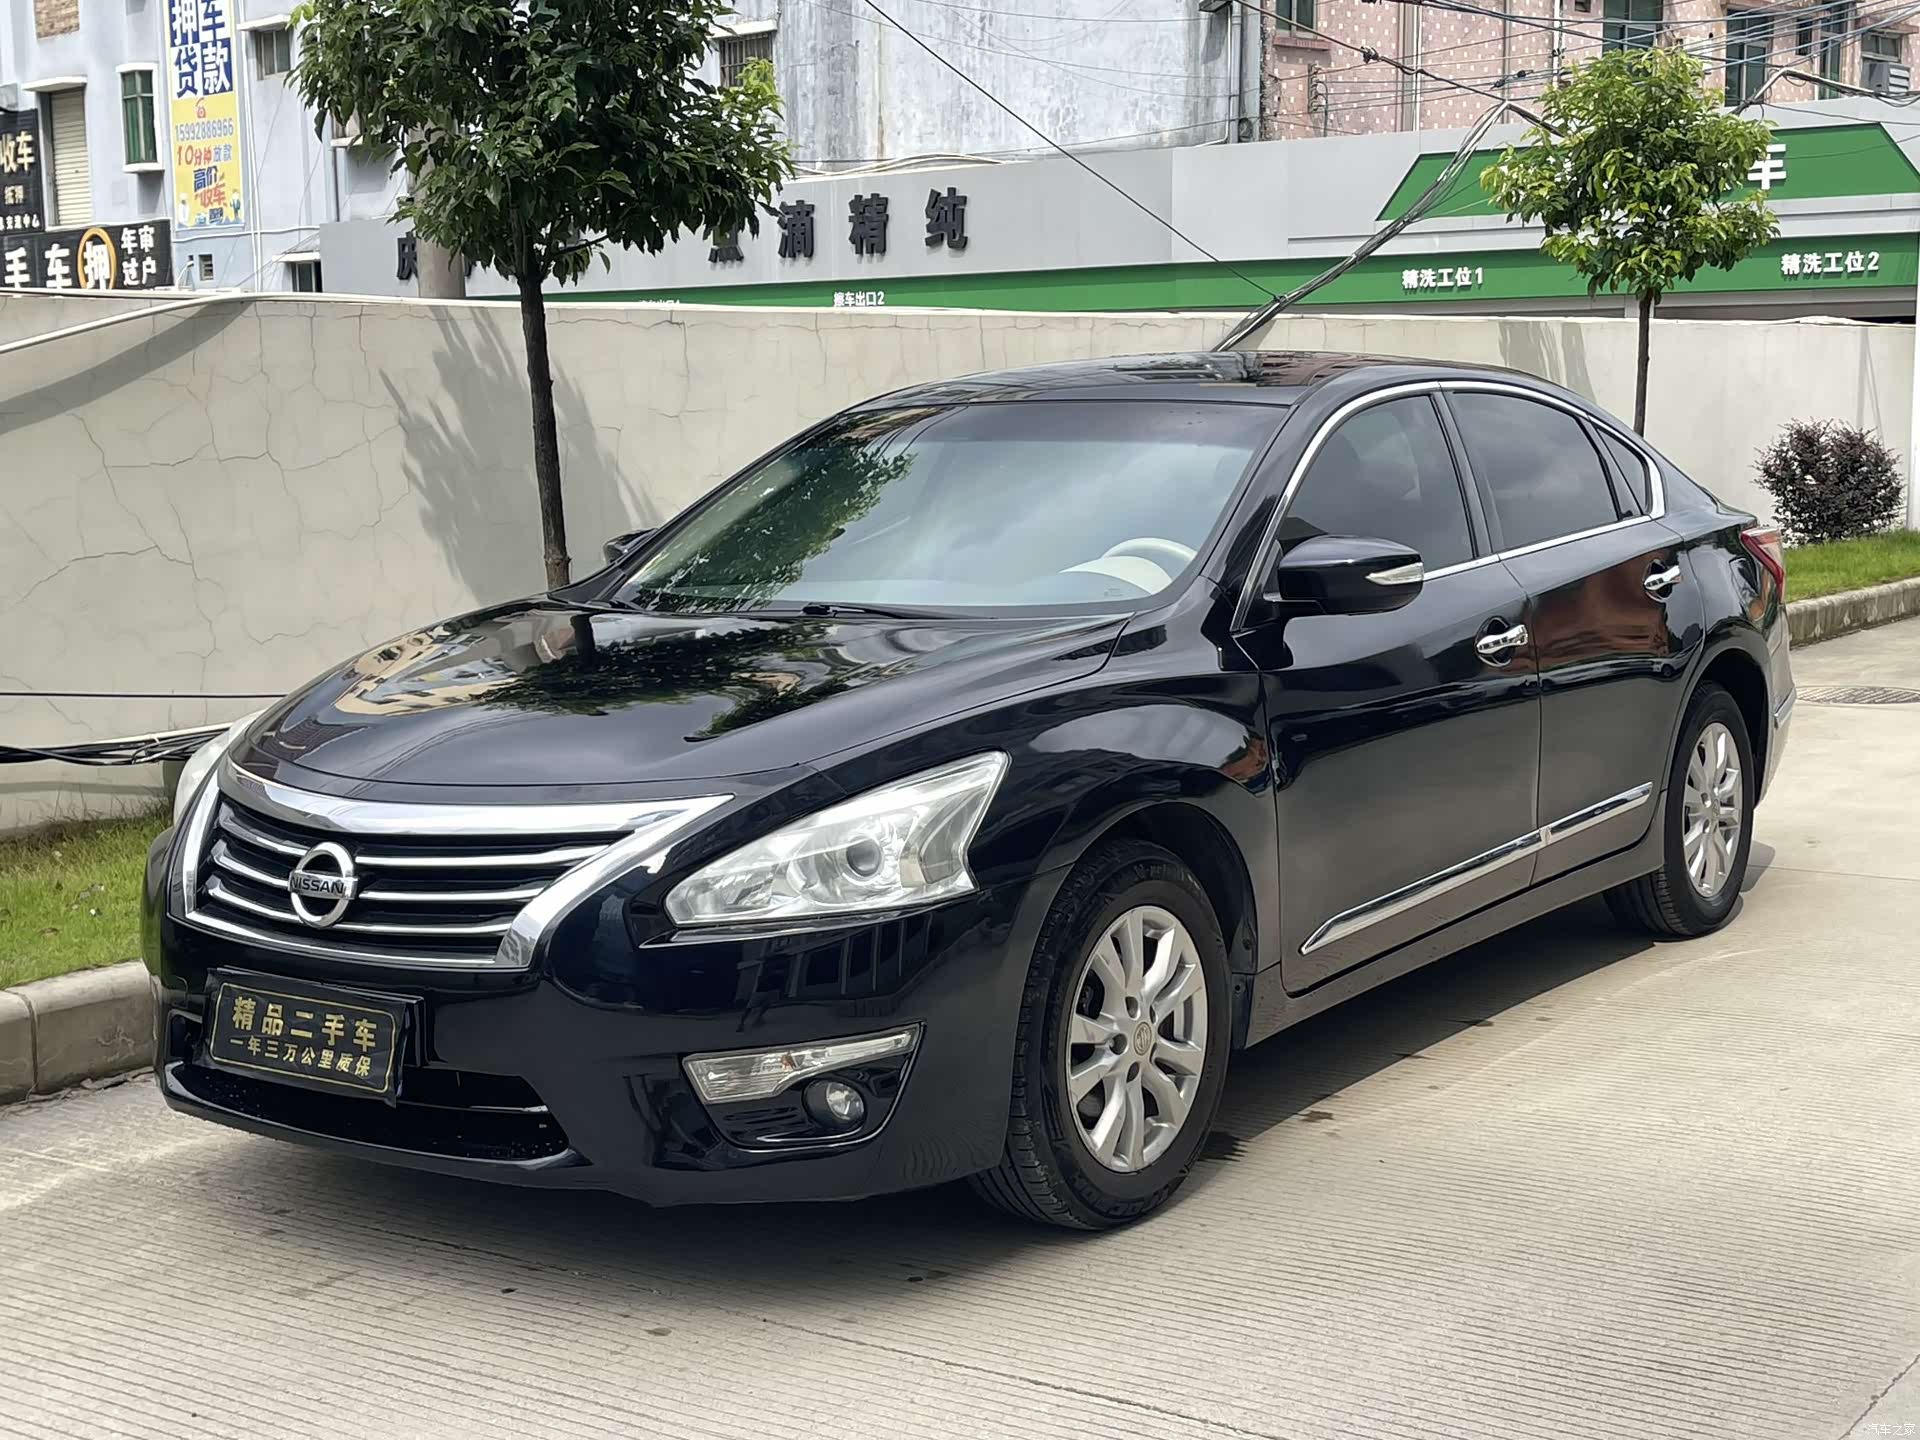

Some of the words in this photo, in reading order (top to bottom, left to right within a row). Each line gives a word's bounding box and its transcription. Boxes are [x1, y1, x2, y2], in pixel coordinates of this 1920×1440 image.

[170, 0, 226, 46] 押车
[173, 40, 231, 98] 贷款
[193, 165, 218, 192] 高价
[199, 183, 227, 208] 收车
[121, 225, 155, 255] 年审
[122, 256, 157, 287] 过户
[1401, 266, 1483, 289] 精洗工位1
[1781, 250, 1880, 275] 精洗工位2
[290, 876, 346, 894] NISSAN
[232, 995, 377, 1053] 精品二手车
[229, 1035, 373, 1077] 一年三万公里质保
